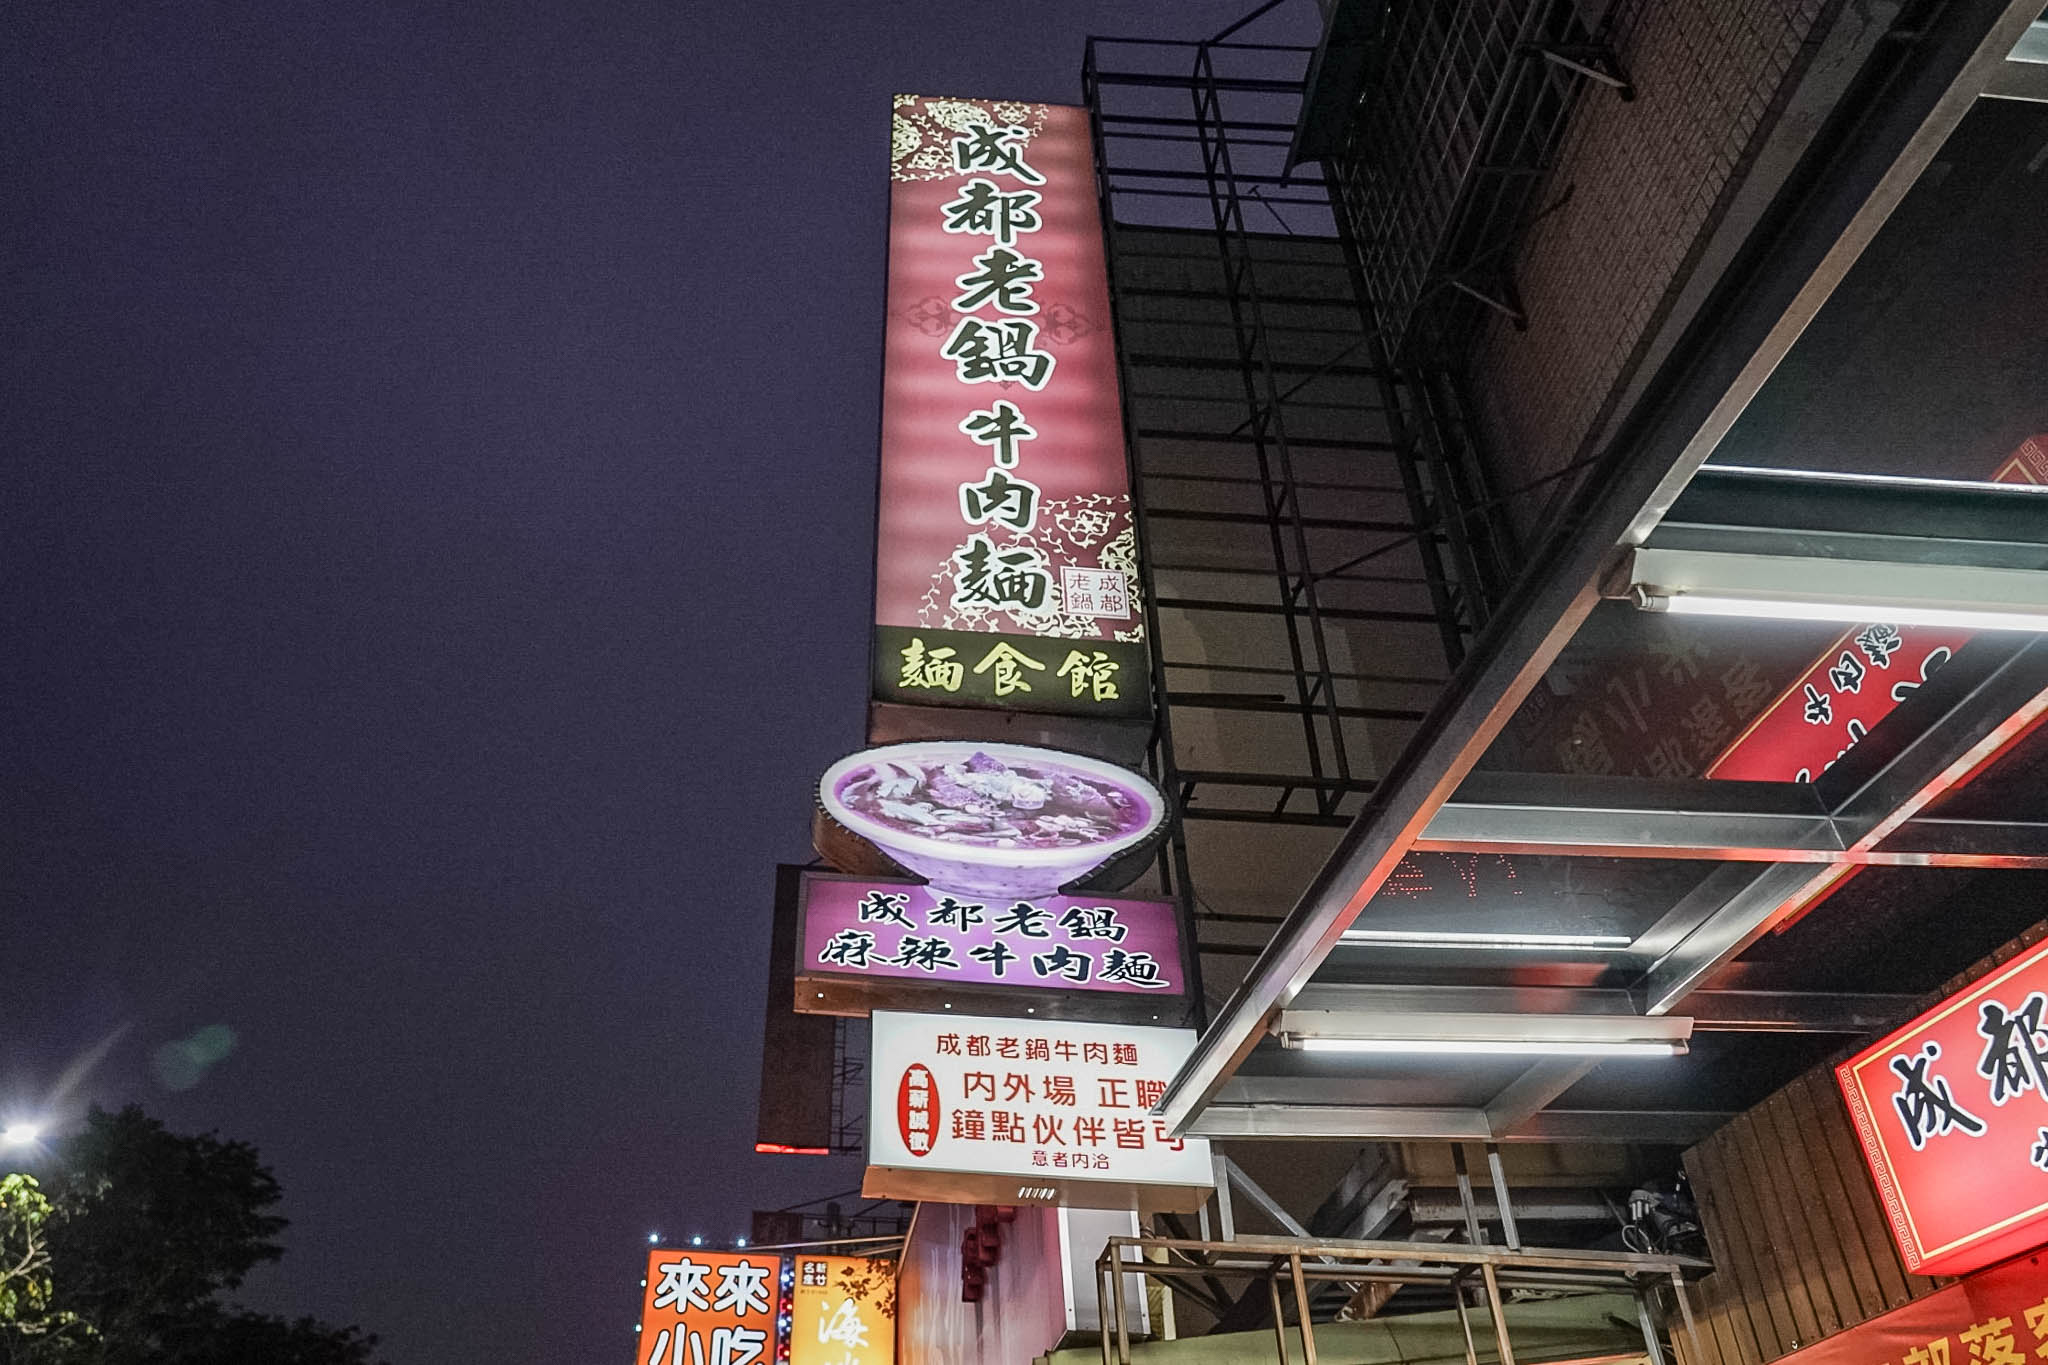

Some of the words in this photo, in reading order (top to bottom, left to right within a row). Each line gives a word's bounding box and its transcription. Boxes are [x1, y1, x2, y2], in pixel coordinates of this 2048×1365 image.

[943, 124, 1053, 612] 成都老鍋牛肉麵
[898, 638, 1120, 701] 麵食館
[858, 891, 1128, 942] 成都老鍋
[819, 930, 1170, 988] 麻辣牛肉麵
[936, 1033, 1138, 1066] 成都老鍋牛肉麵
[653, 1257, 771, 1316] 來來
[648, 1322, 767, 1365] 小吃
